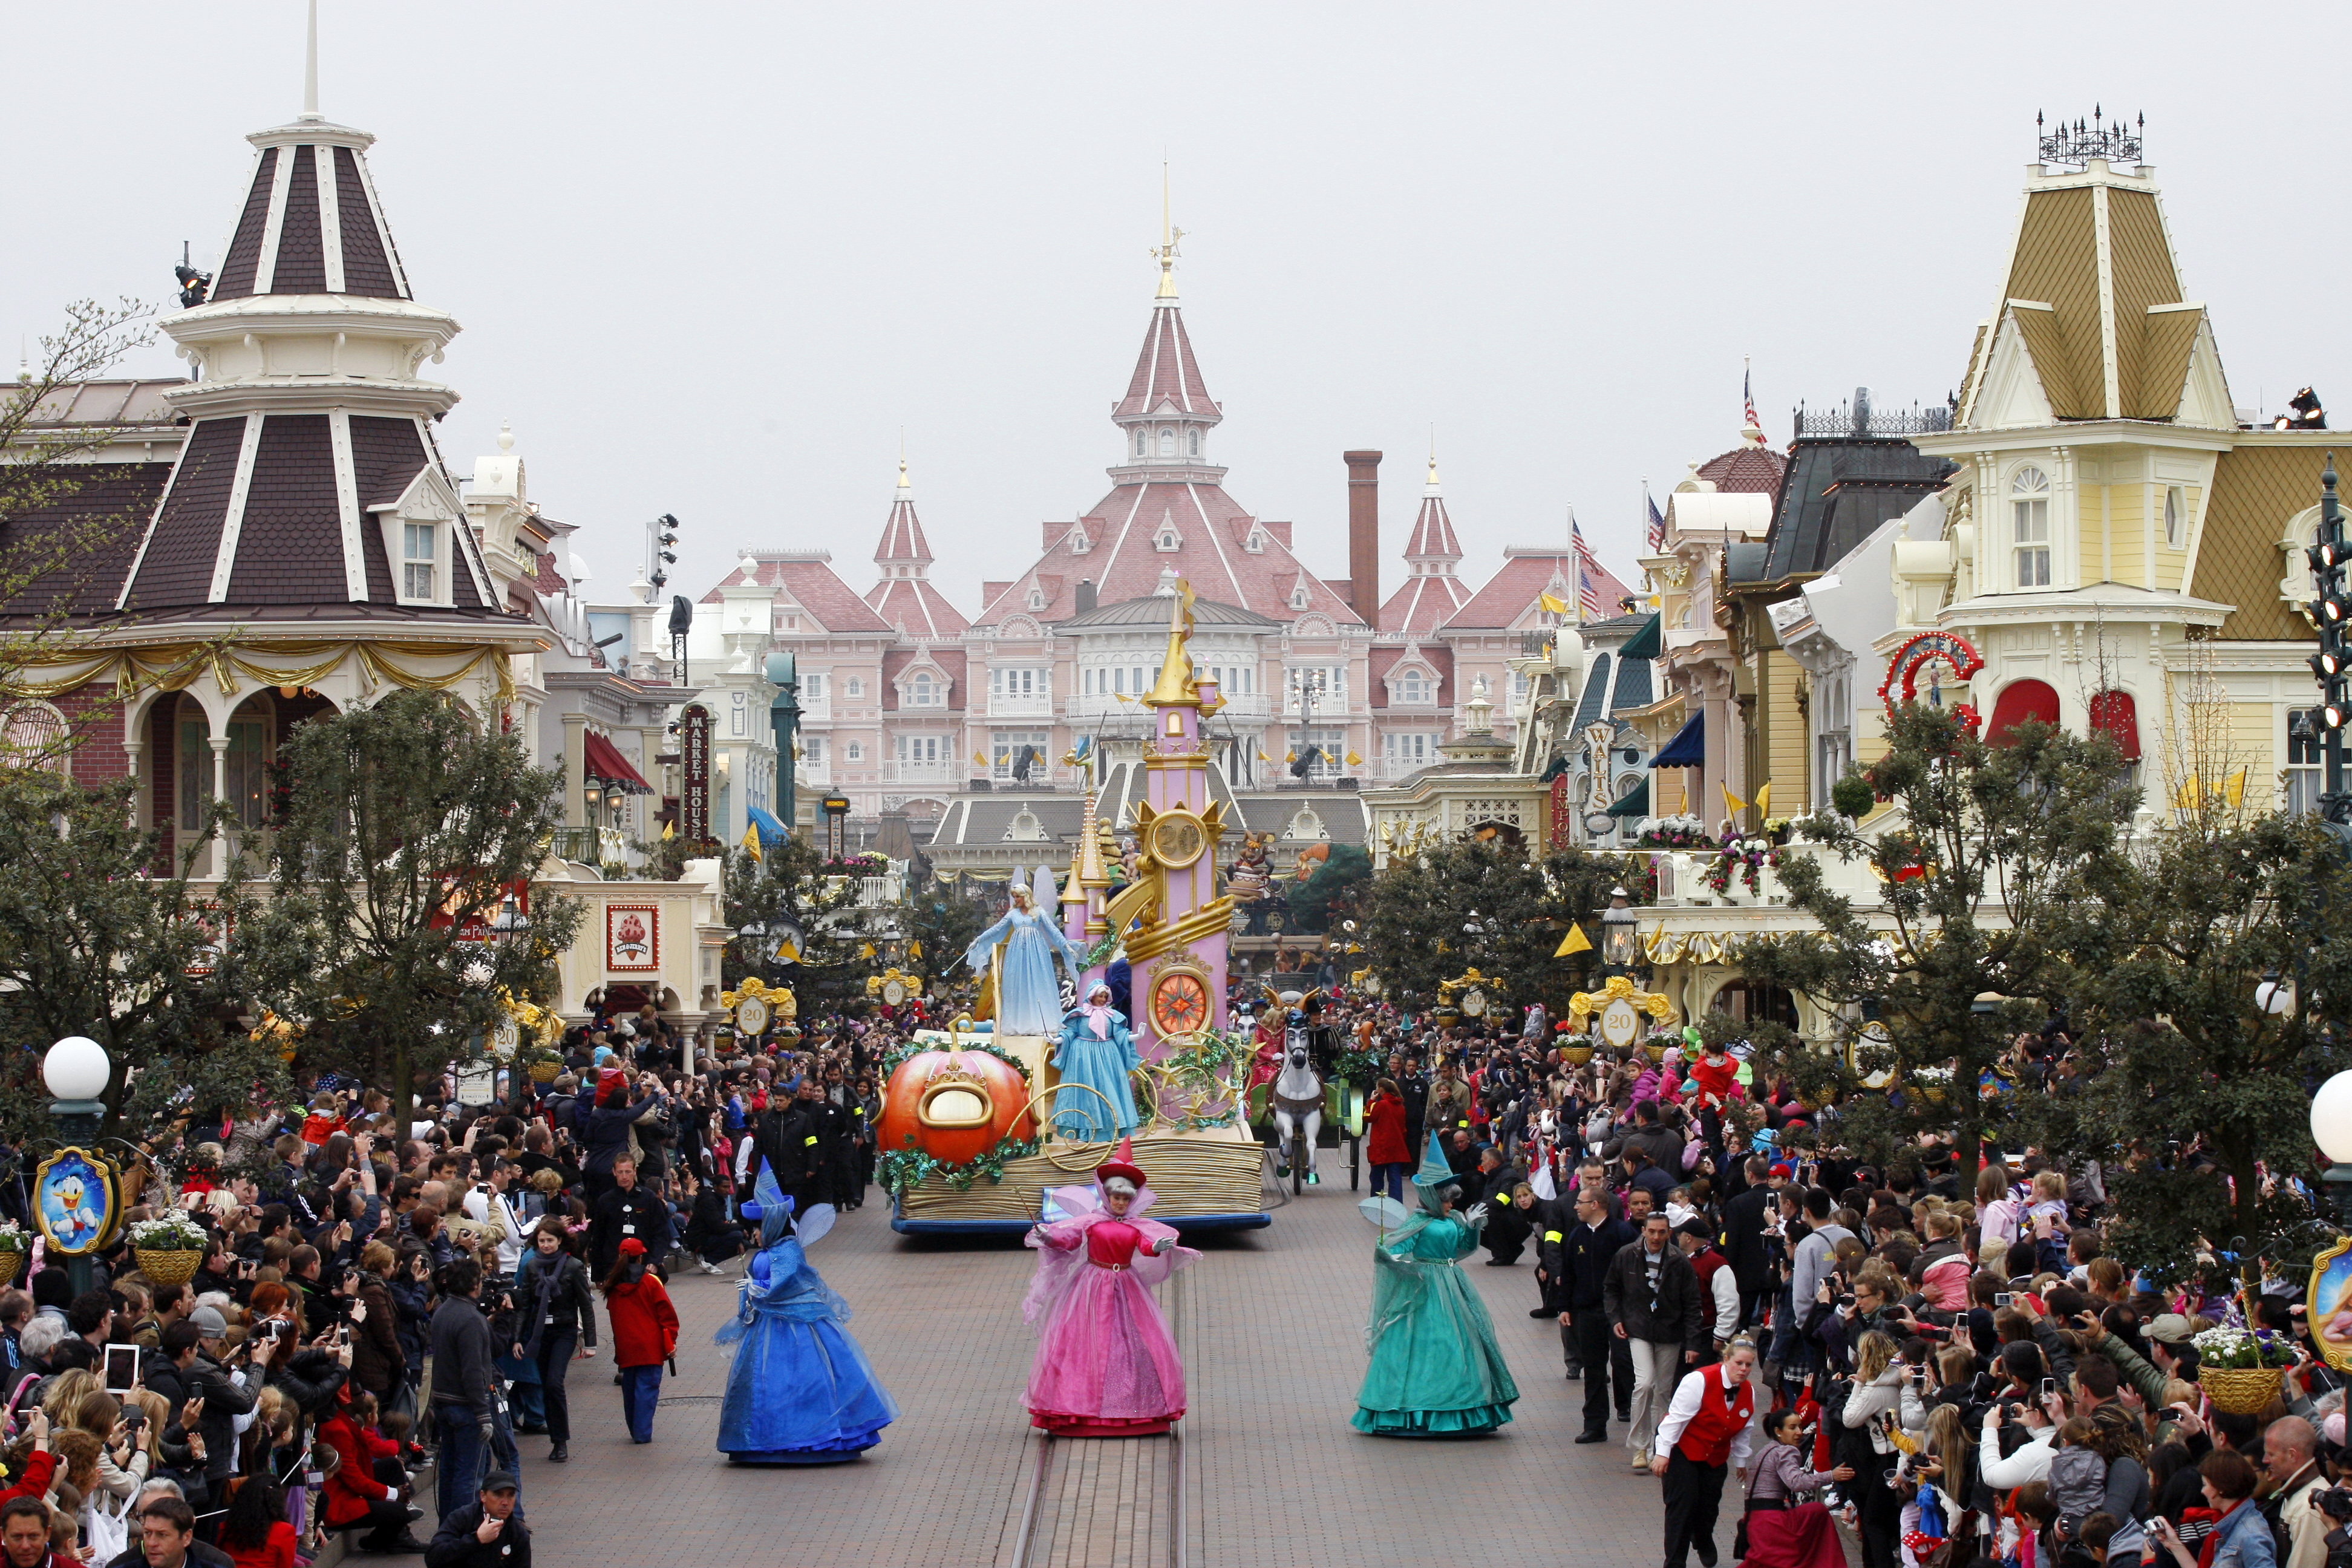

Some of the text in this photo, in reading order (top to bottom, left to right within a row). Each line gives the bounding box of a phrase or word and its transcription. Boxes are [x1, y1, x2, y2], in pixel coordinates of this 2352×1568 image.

[690, 717, 703, 840] MARKET HOUSE
[1159, 823, 1199, 855] 20
[888, 988, 900, 997] 20
[1466, 994, 1481, 1005] 20
[744, 1009, 762, 1021] 20
[1609, 1014, 1631, 1029] 20
[498, 1028, 514, 1045] 20
